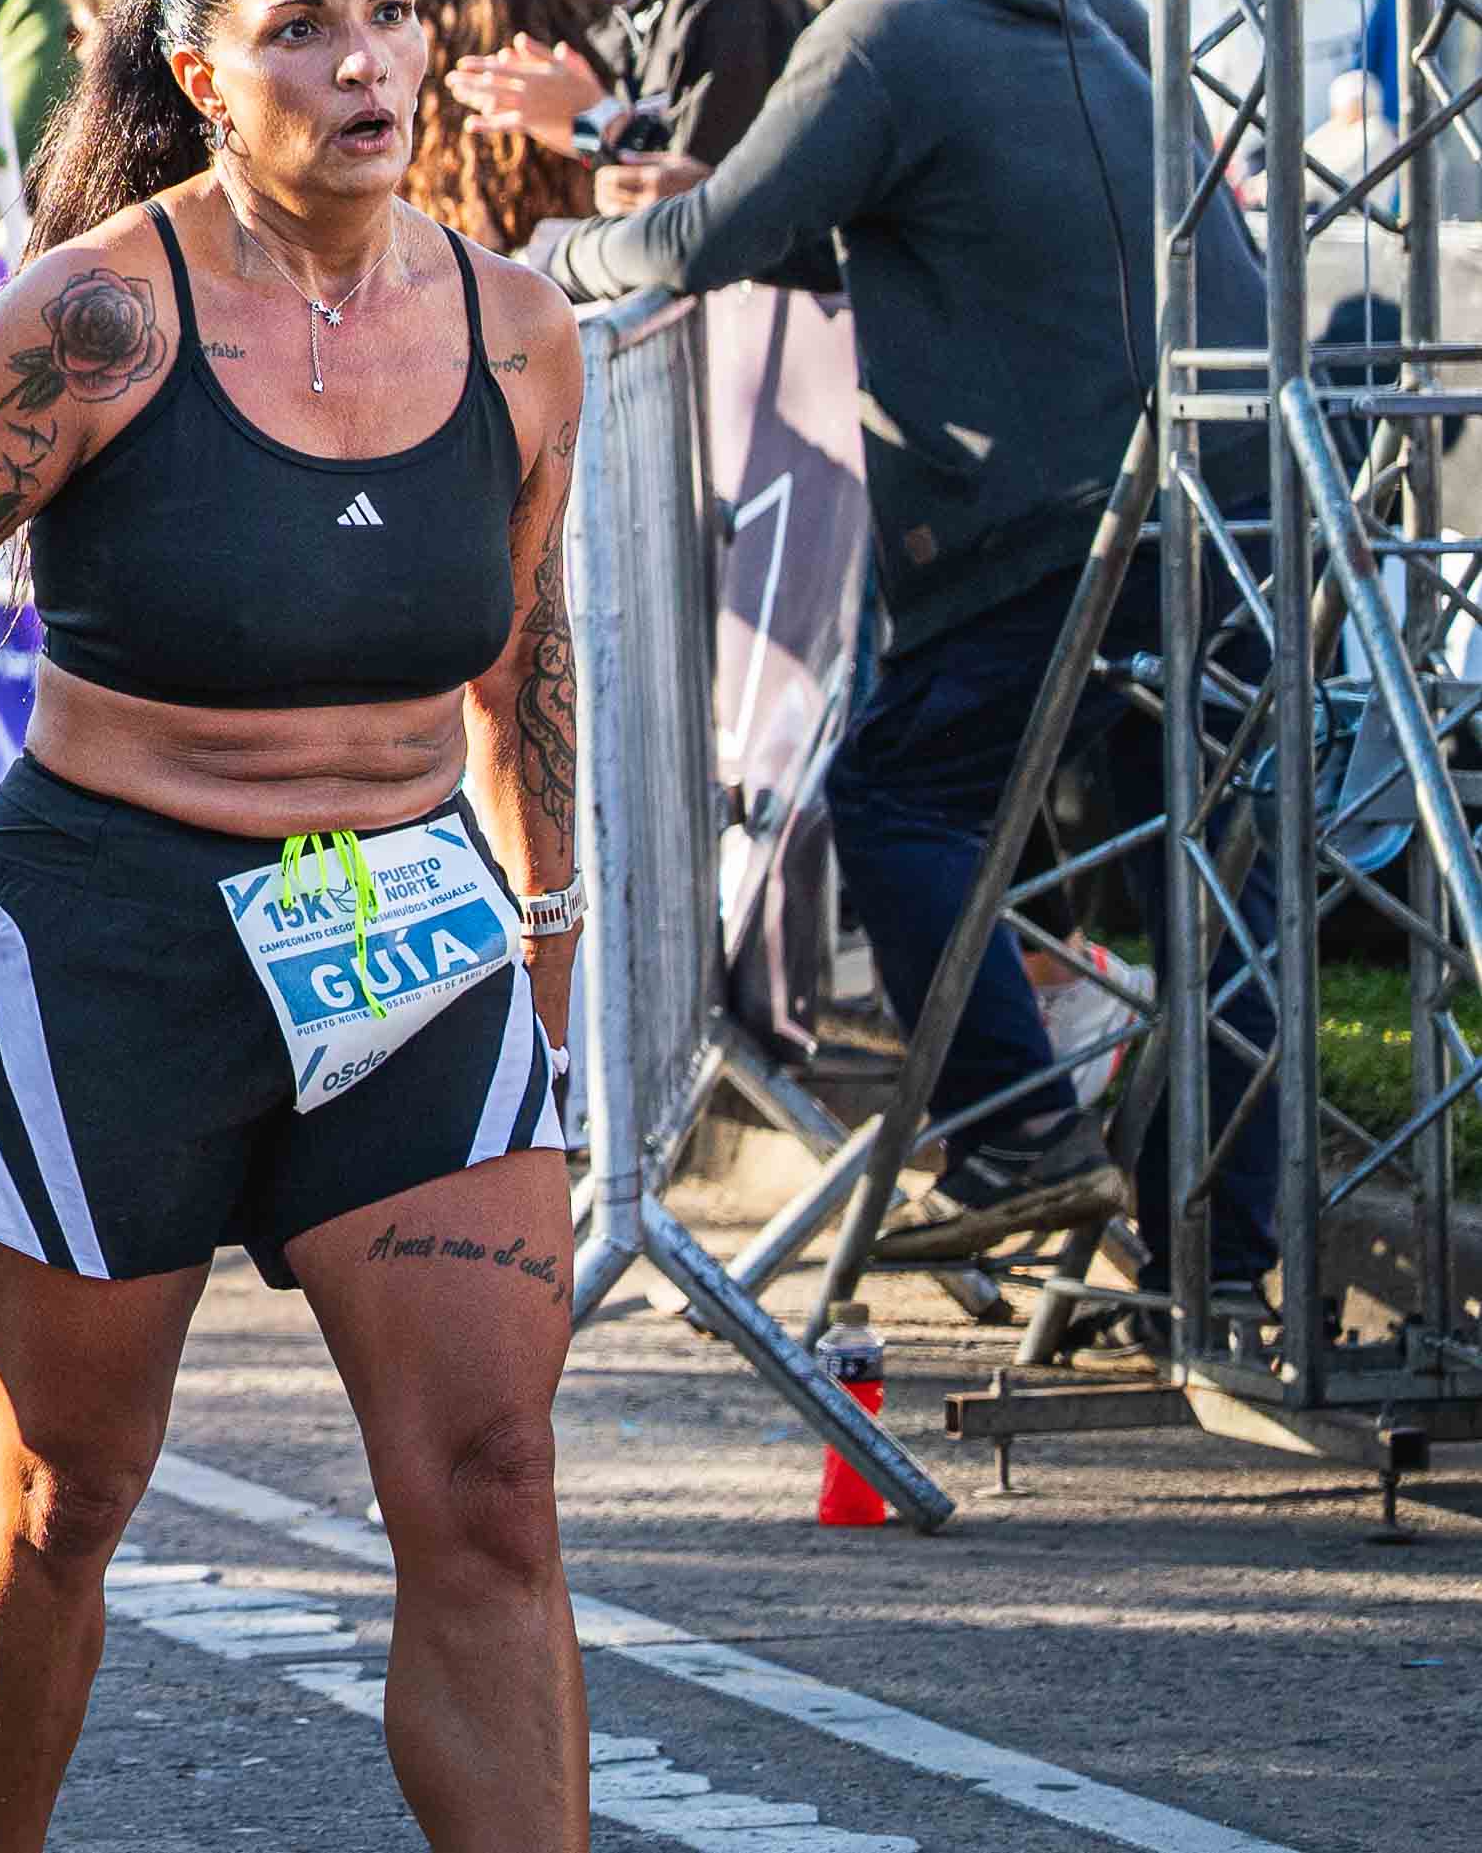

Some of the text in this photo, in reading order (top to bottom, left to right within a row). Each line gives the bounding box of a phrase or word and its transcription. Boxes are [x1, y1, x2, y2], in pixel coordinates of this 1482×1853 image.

[378, 856, 442, 886] PUERTO
[385, 874, 440, 902] NORTE
[259, 932, 324, 955] CAMPEONATO
[427, 882, 479, 908] VISUALES
[262, 891, 334, 933] 15K
[310, 927, 481, 1010] GUÍA
[297, 1019, 336, 1037] PUERTO
[338, 1010, 371, 1027] NORTE
[381, 991, 422, 1012] OSARIO
[322, 1049, 388, 1092] osde
